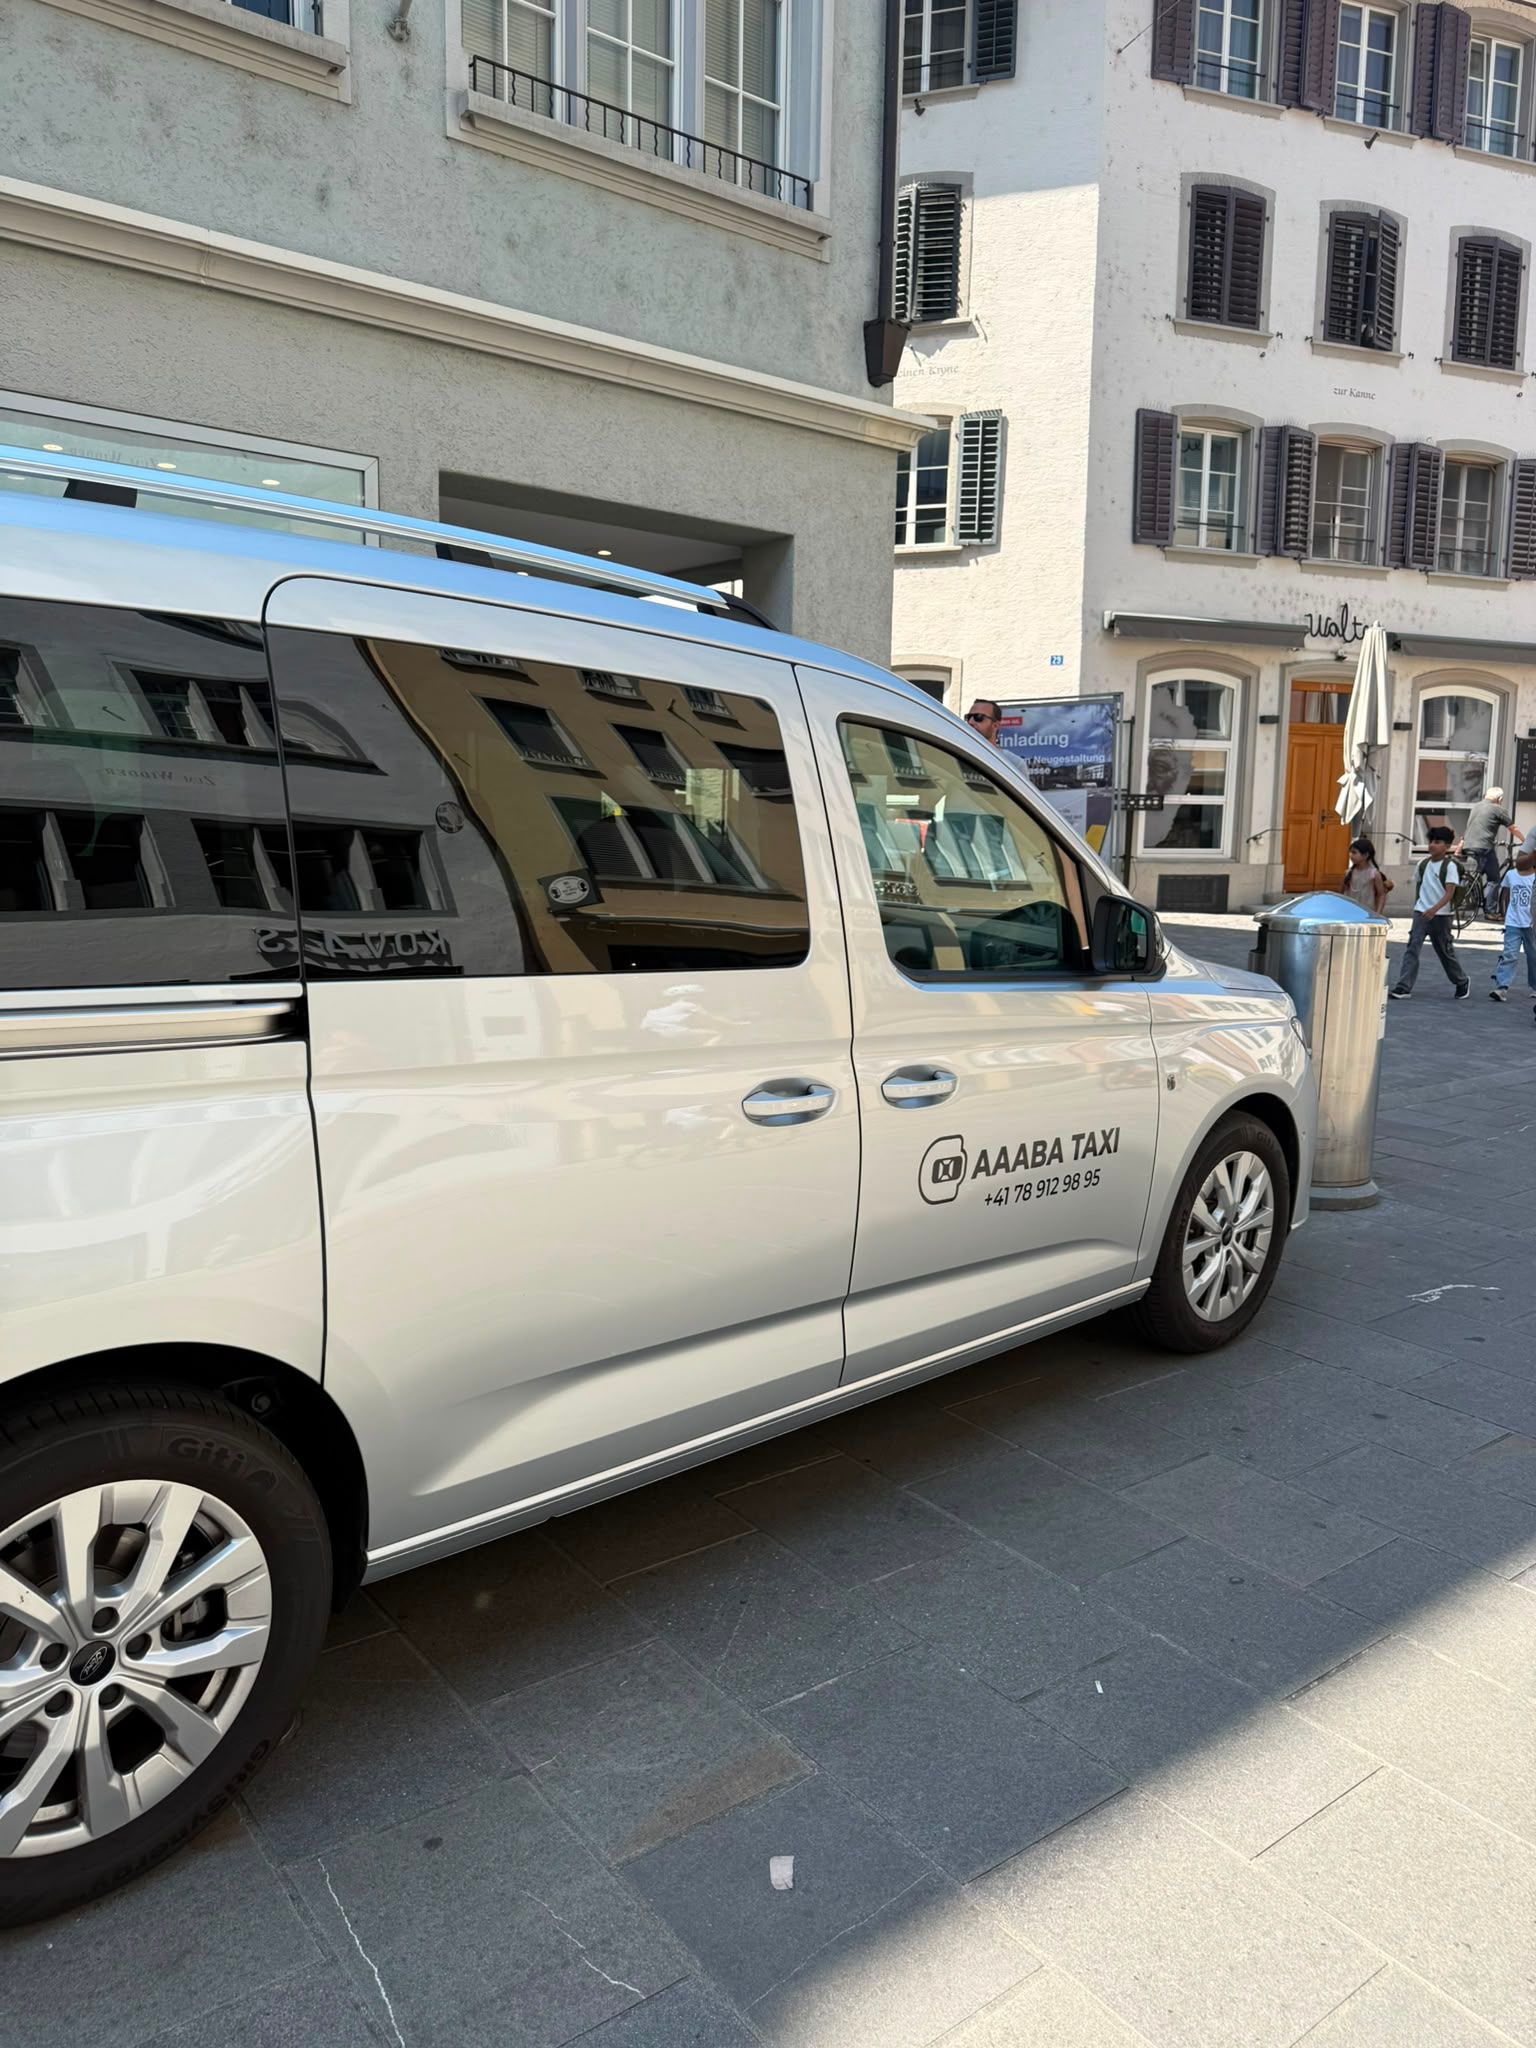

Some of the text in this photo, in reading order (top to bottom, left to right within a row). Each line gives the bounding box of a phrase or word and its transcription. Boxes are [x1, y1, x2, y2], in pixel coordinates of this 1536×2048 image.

[1033, 752, 1105, 766] Neugestaltung
[970, 1126, 1121, 1180] AAABA TAXI
[985, 1168, 1101, 1207] +41 78 912 98 95
